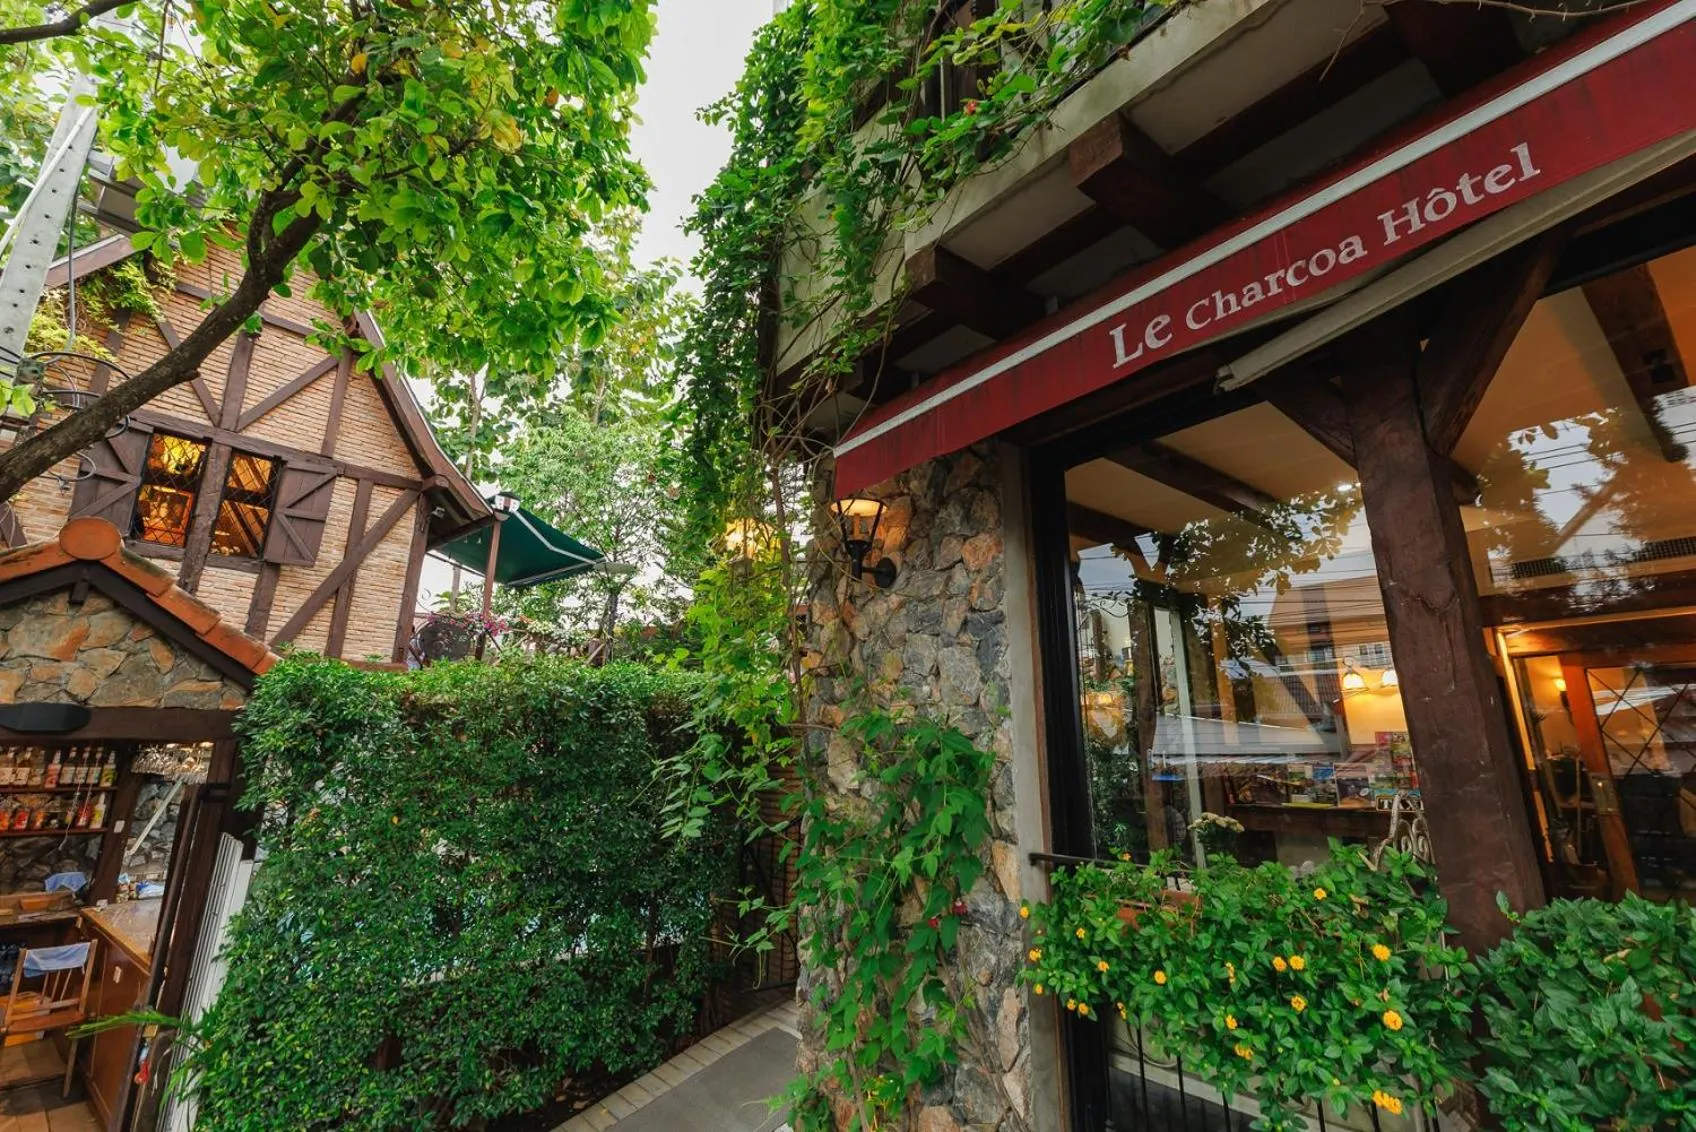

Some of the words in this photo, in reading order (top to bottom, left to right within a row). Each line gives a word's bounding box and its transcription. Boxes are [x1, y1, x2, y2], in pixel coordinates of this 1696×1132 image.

[1110, 314, 1173, 369] Le
[1186, 235, 1368, 330] Charcoa
[1377, 143, 1541, 247] Hôtel
